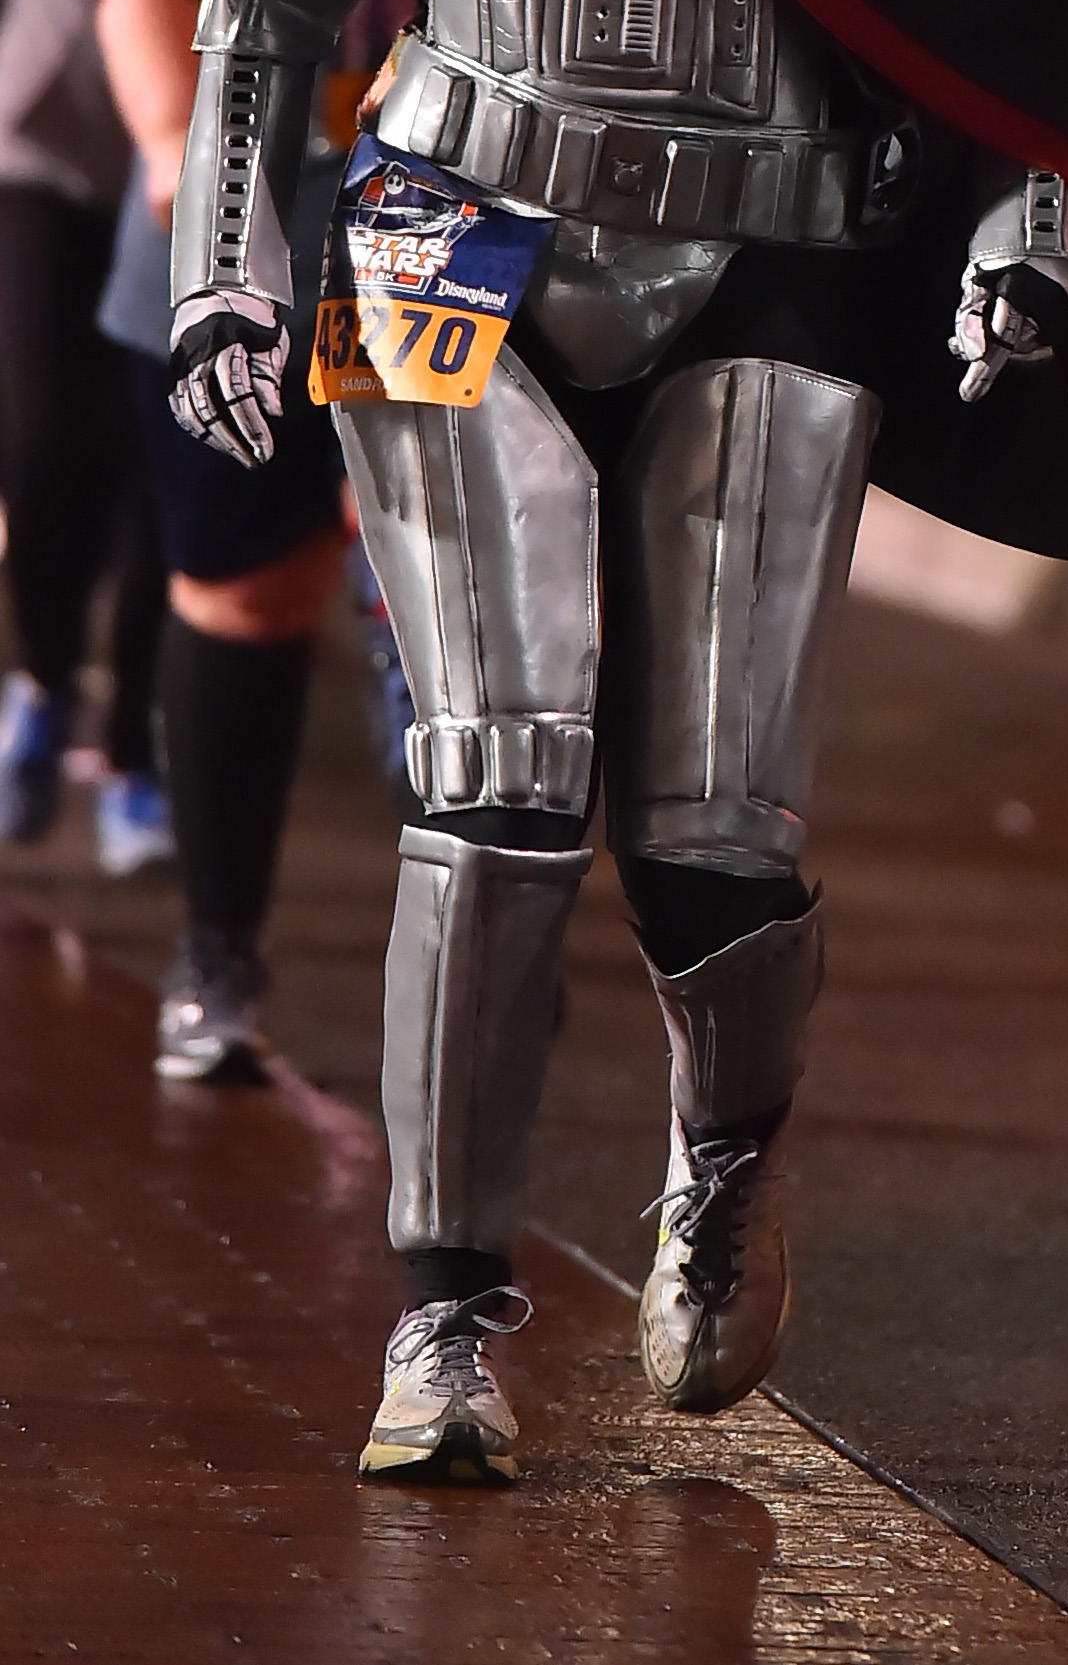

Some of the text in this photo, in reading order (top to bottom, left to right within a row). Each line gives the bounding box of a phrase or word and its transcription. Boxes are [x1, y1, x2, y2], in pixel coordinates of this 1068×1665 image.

[348, 230, 450, 258] STAR
[348, 244, 446, 277] WARS
[376, 272, 395, 282] 5K
[434, 278, 508, 309] Disneyland
[316, 304, 477, 375] 43270
